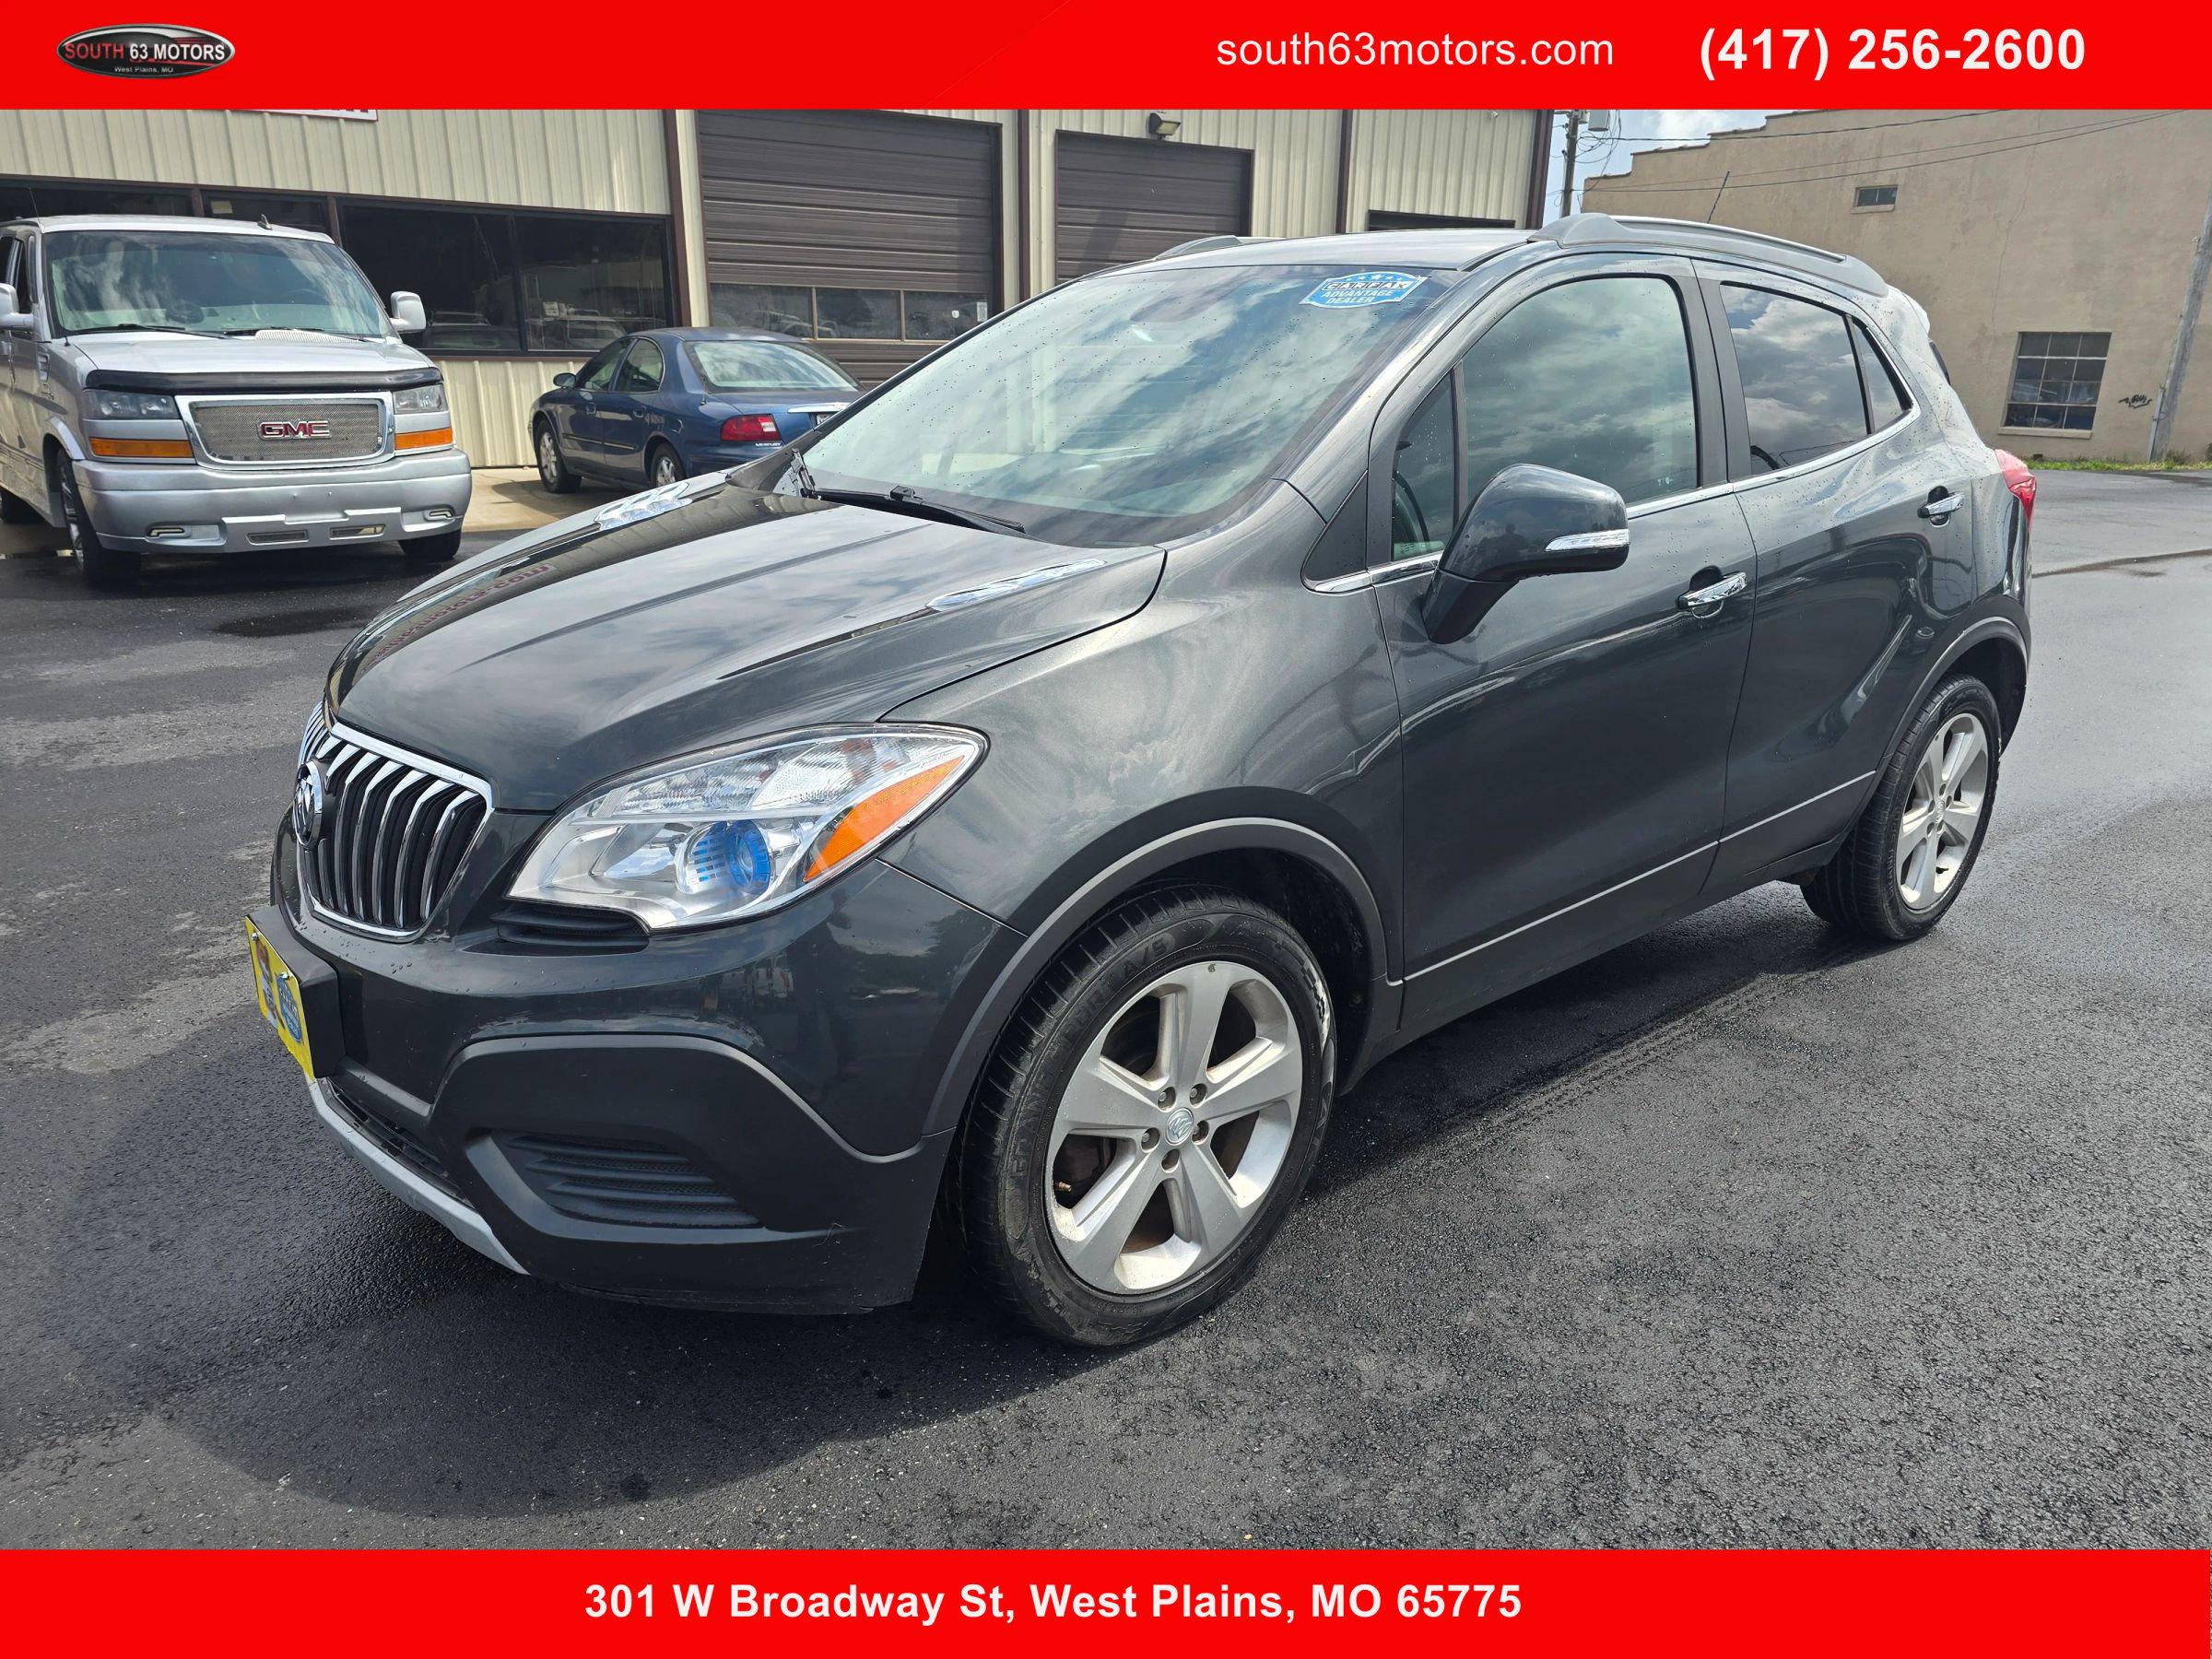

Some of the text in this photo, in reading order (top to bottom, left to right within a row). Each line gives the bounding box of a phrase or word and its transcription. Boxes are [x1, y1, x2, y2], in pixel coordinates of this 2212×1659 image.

[1325, 281, 1407, 290] CARFAX
[1321, 289, 1394, 298] ADVANTAGE
[1325, 296, 1375, 304] DEALER
[259, 420, 331, 439] GMC
